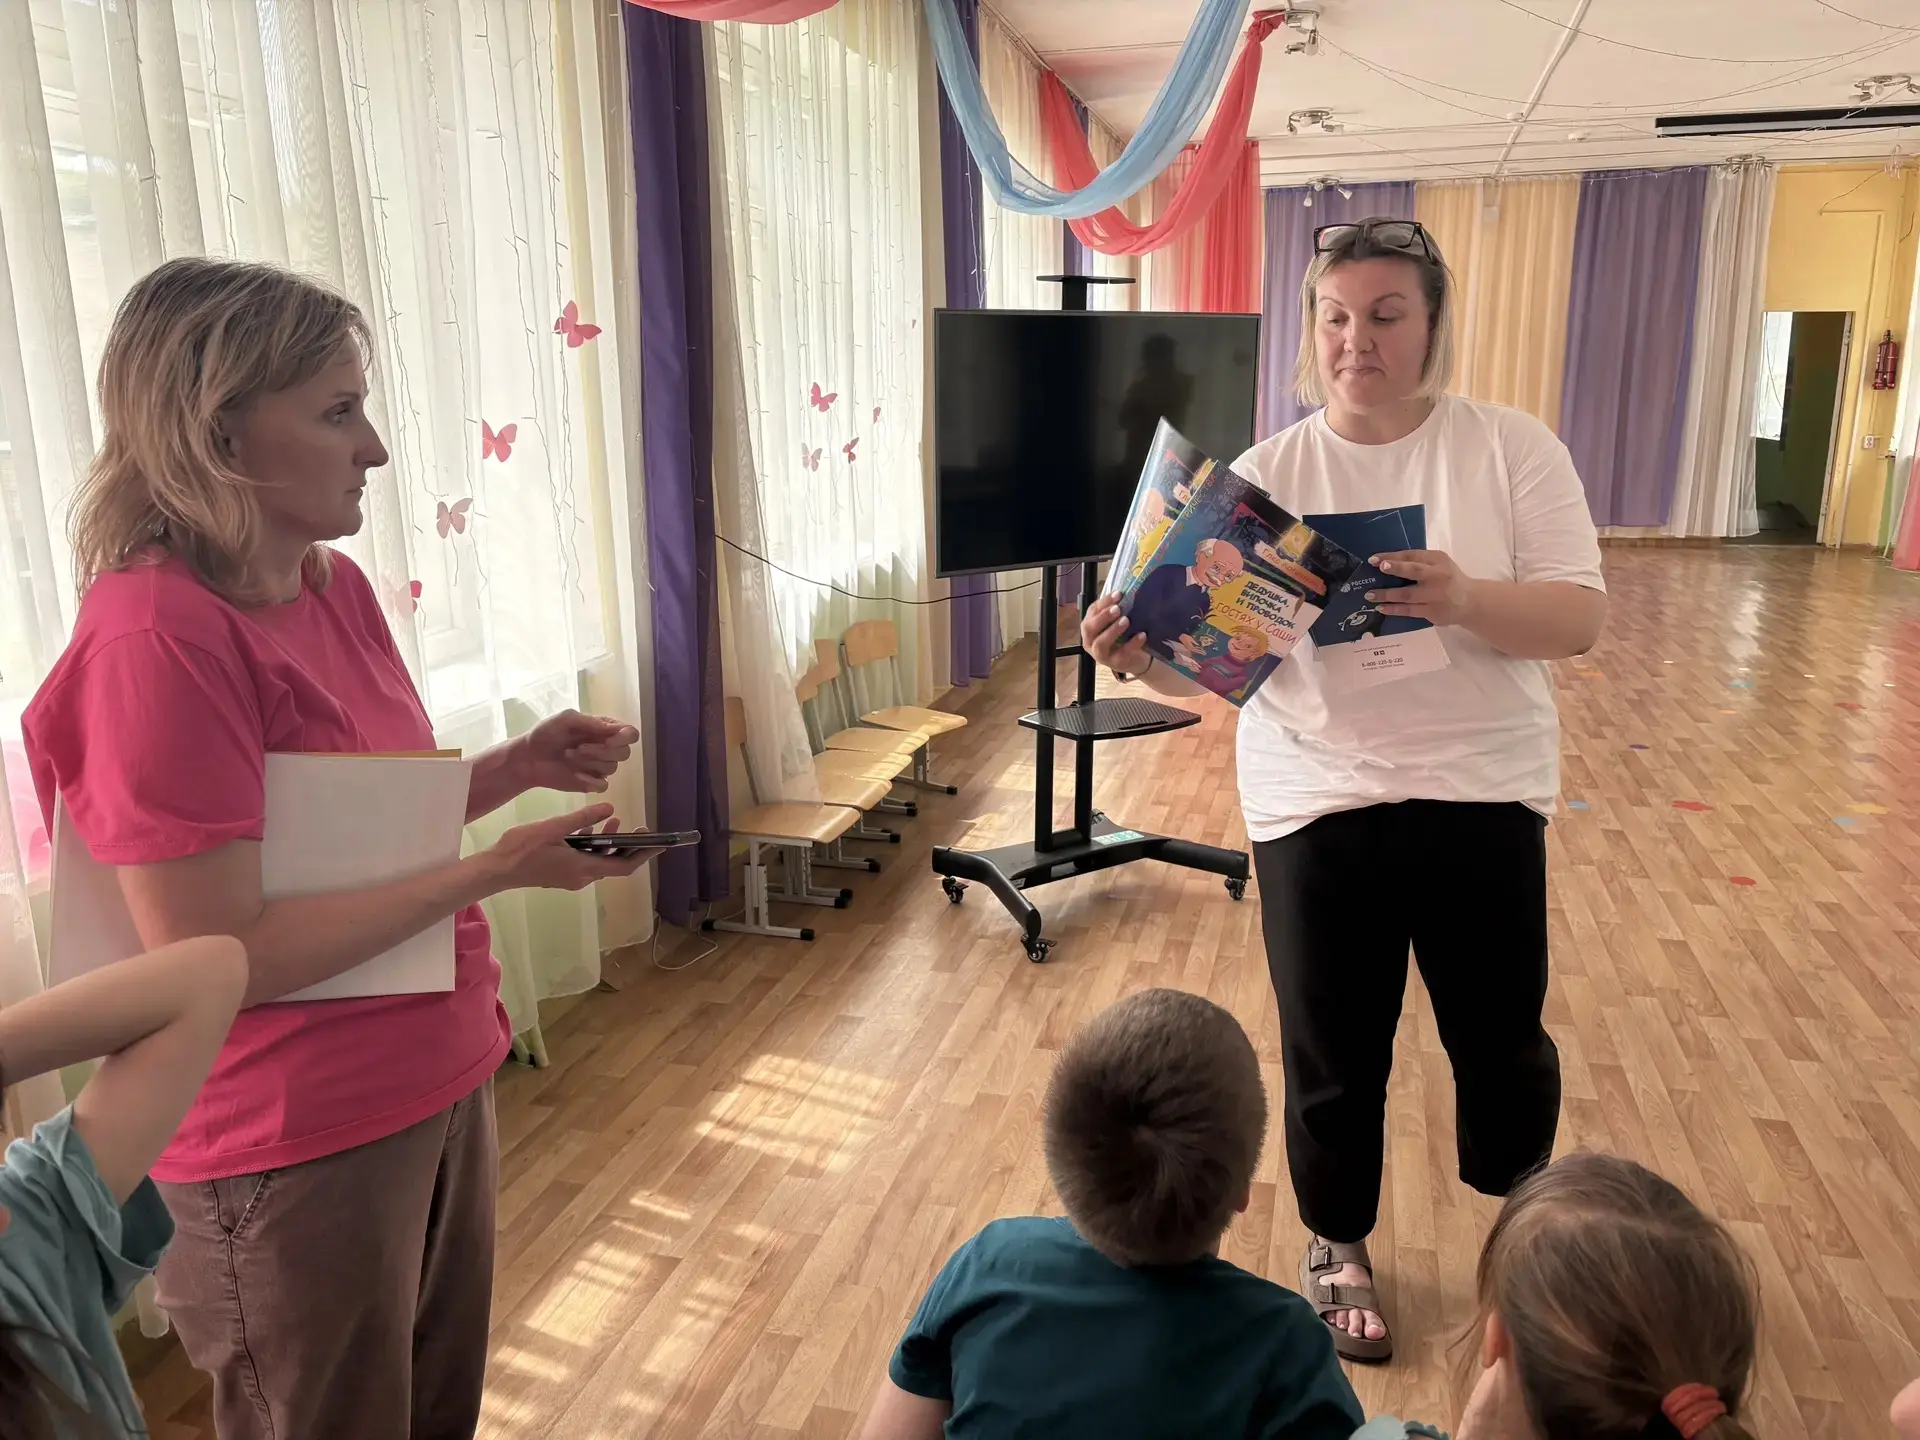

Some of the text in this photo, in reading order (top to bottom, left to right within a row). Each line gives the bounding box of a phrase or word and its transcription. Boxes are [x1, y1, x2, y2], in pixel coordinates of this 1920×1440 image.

[1245, 581, 1290, 607] ДЕДУШКА,
[1351, 577, 1377, 587] РОССЕТИ
[1236, 597, 1297, 629] И ПРОВОДОК
[1240, 588, 1283, 613] ВИЛОЧКА
